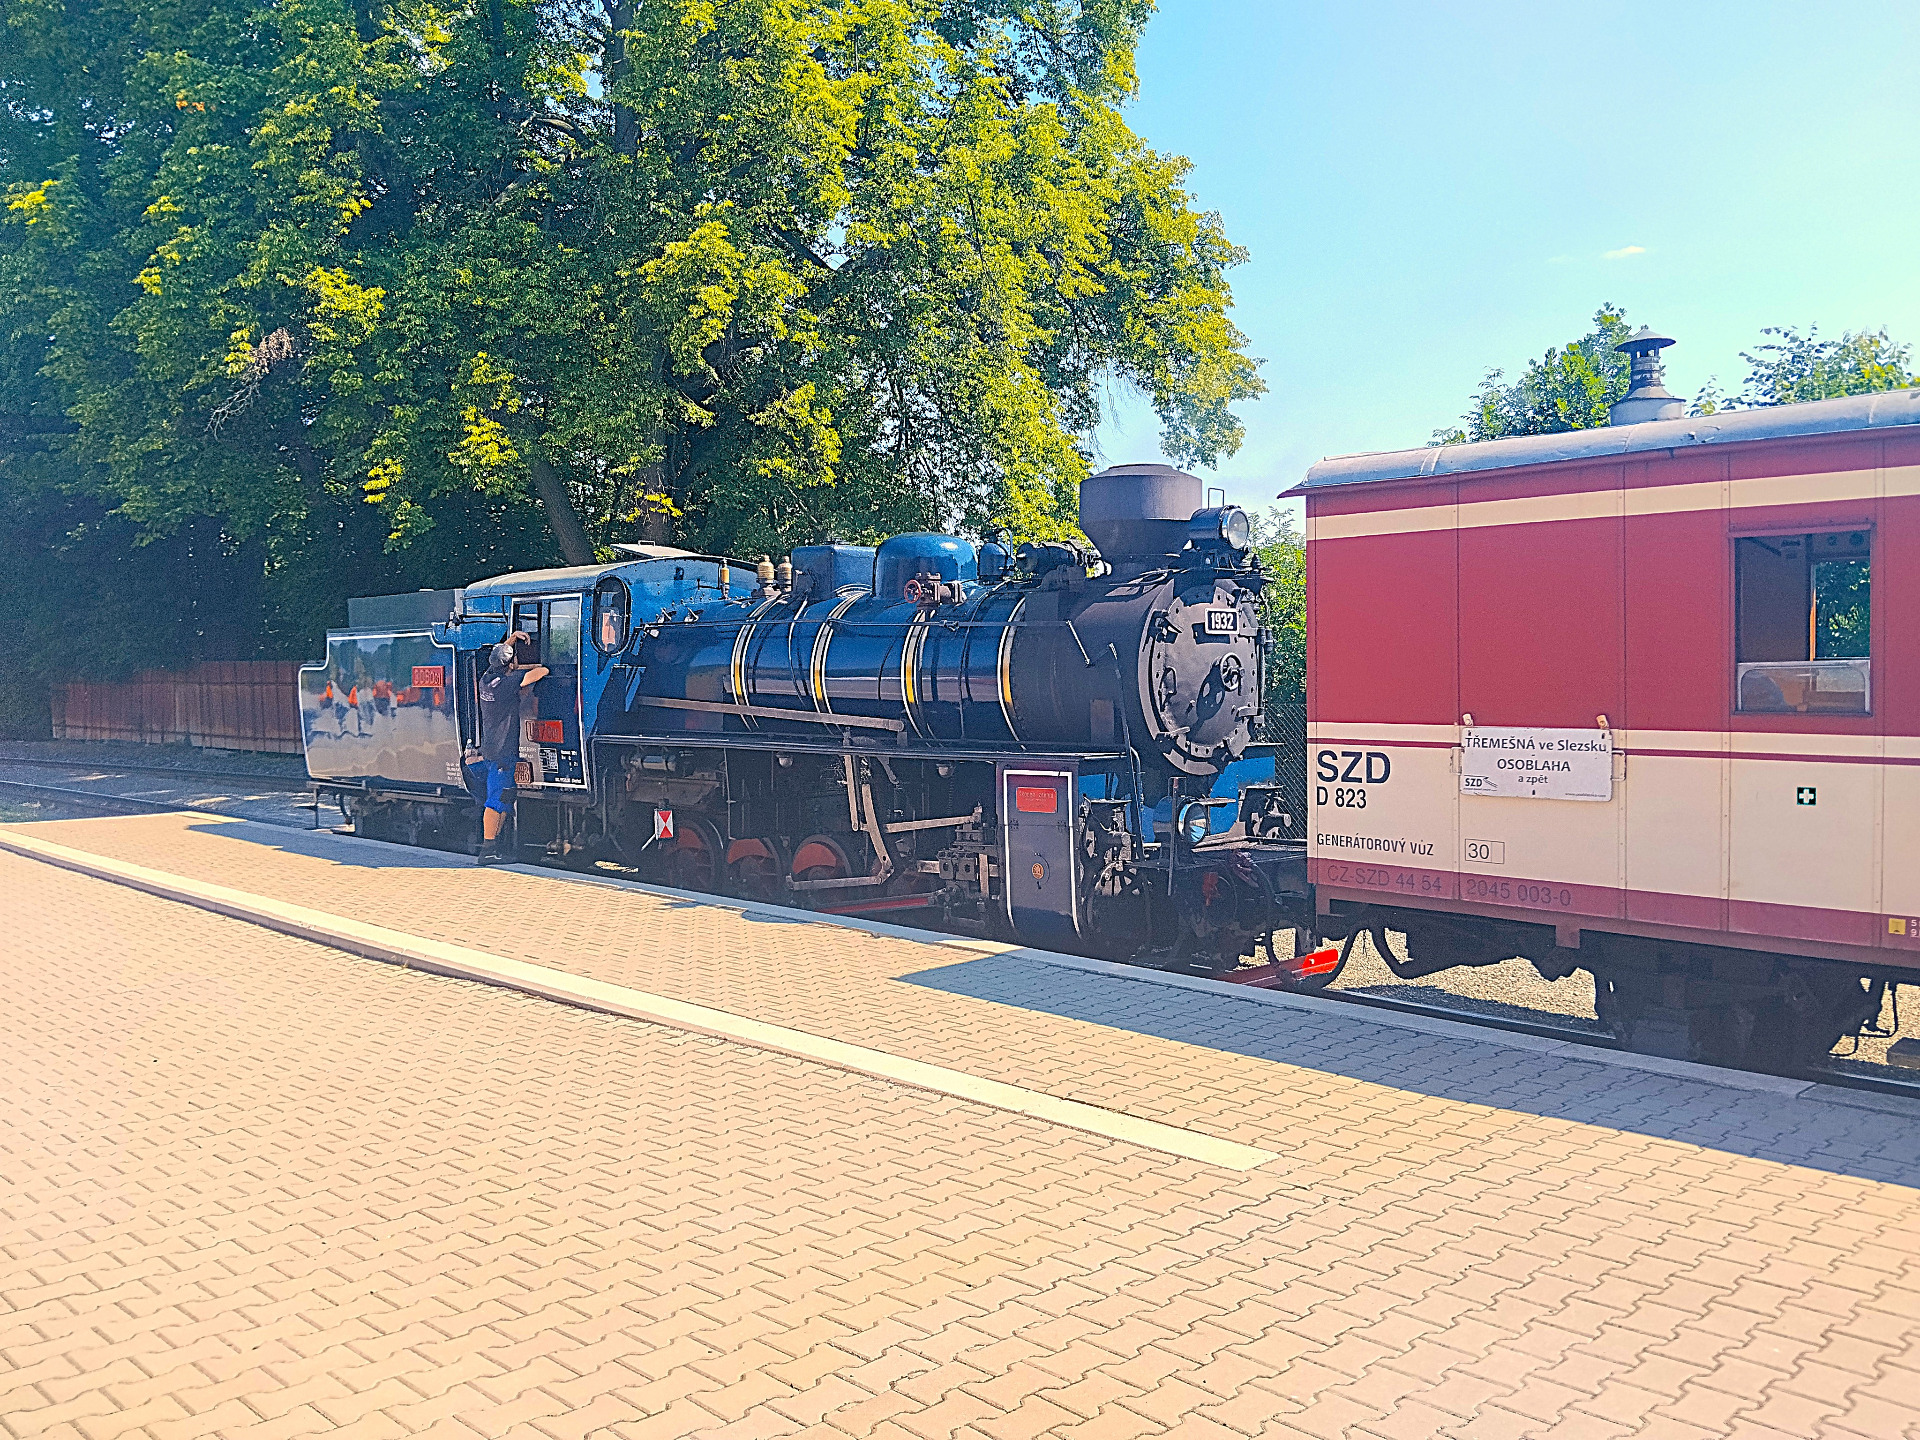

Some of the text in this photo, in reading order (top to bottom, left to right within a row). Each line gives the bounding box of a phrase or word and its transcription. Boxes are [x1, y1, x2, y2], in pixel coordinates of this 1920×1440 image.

[1211, 612, 1234, 630] 1932
[1465, 735, 1607, 752] TŘEMEŠNÁ ve Slezsku
[1316, 750, 1391, 784] SZD
[1497, 758, 1571, 772] OSOBLAHA
[1464, 778, 1483, 787] SZD
[1526, 775, 1549, 786] zpět
[1316, 786, 1367, 809] D 823
[1317, 833, 1406, 853] GENERÁTOROVÝ
[1468, 843, 1490, 860] 30
[1328, 864, 1572, 907] CZ-SZD 44 54 2045 003-0
